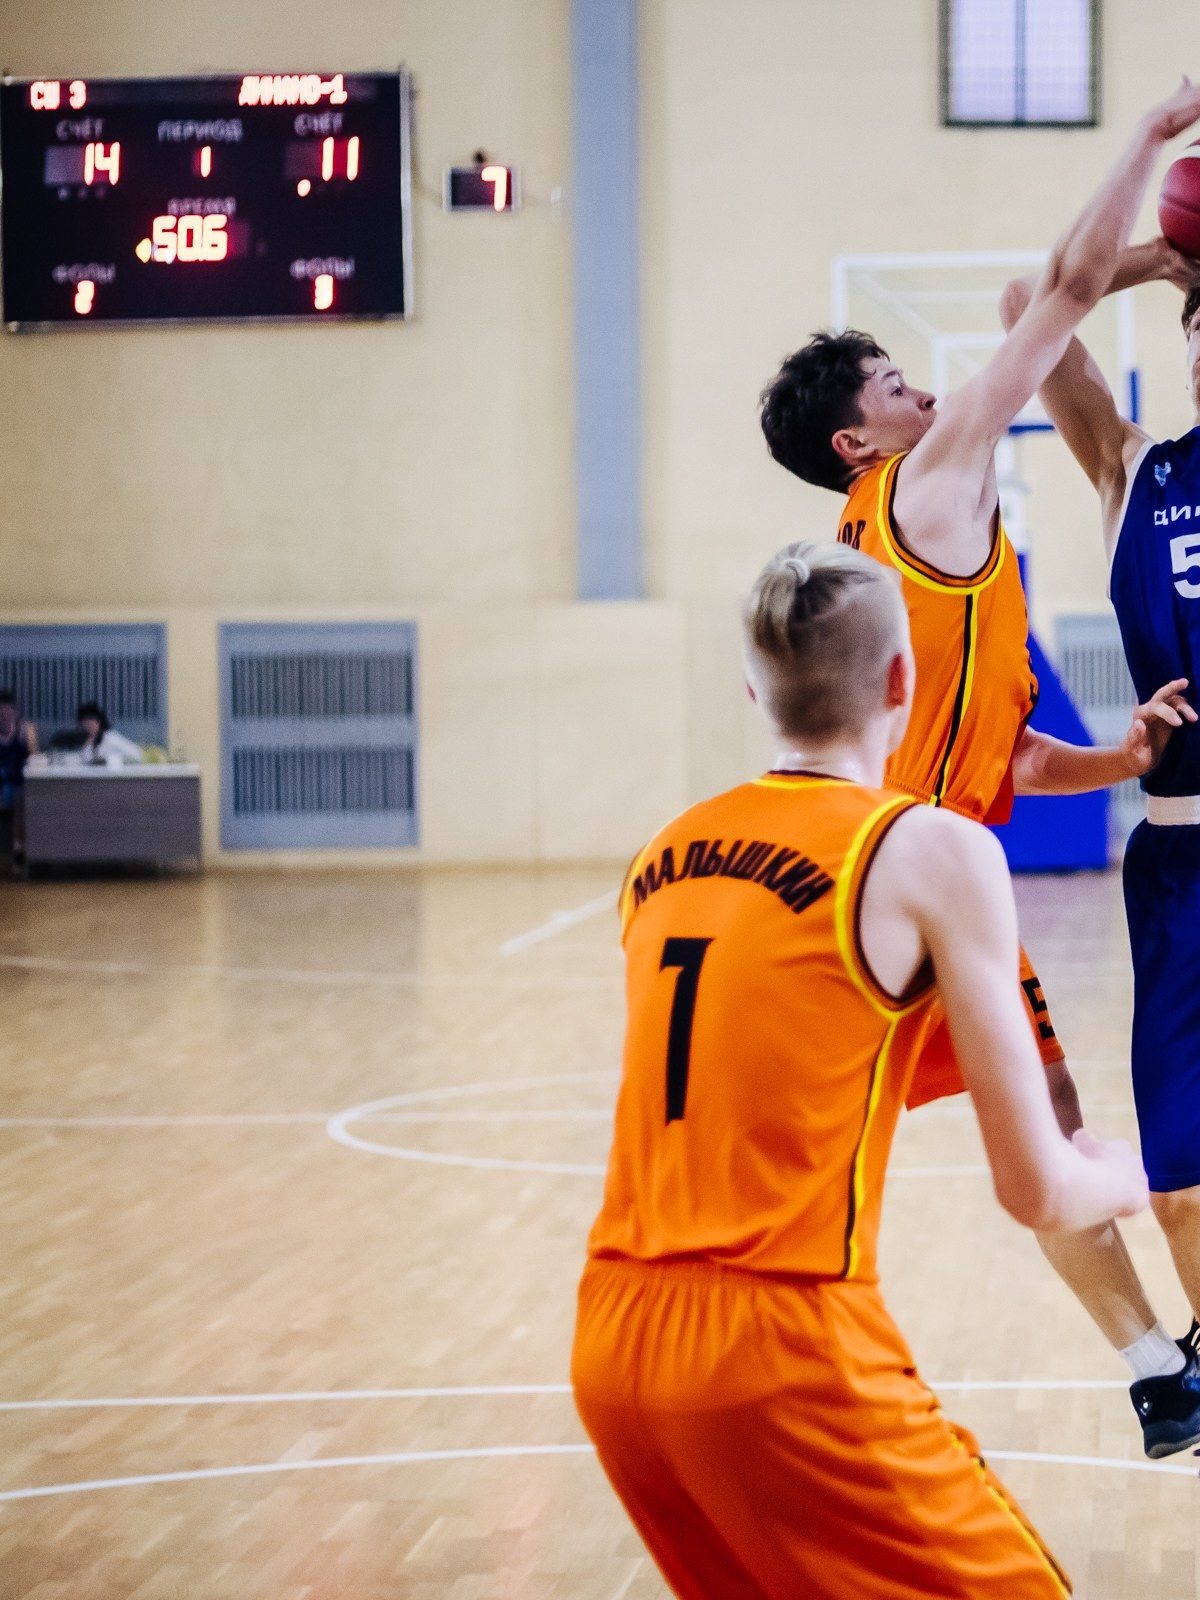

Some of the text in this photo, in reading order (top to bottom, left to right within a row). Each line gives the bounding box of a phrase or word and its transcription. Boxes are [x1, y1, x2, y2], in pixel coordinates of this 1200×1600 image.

[69, 80, 87, 110] 3
[83, 142, 120, 186] 14
[200, 145, 211, 178] 1
[321, 135, 360, 182] 11
[481, 165, 507, 212] 7
[632, 838, 836, 916] МАЛЫШКИН
[658, 936, 716, 1127] 1
